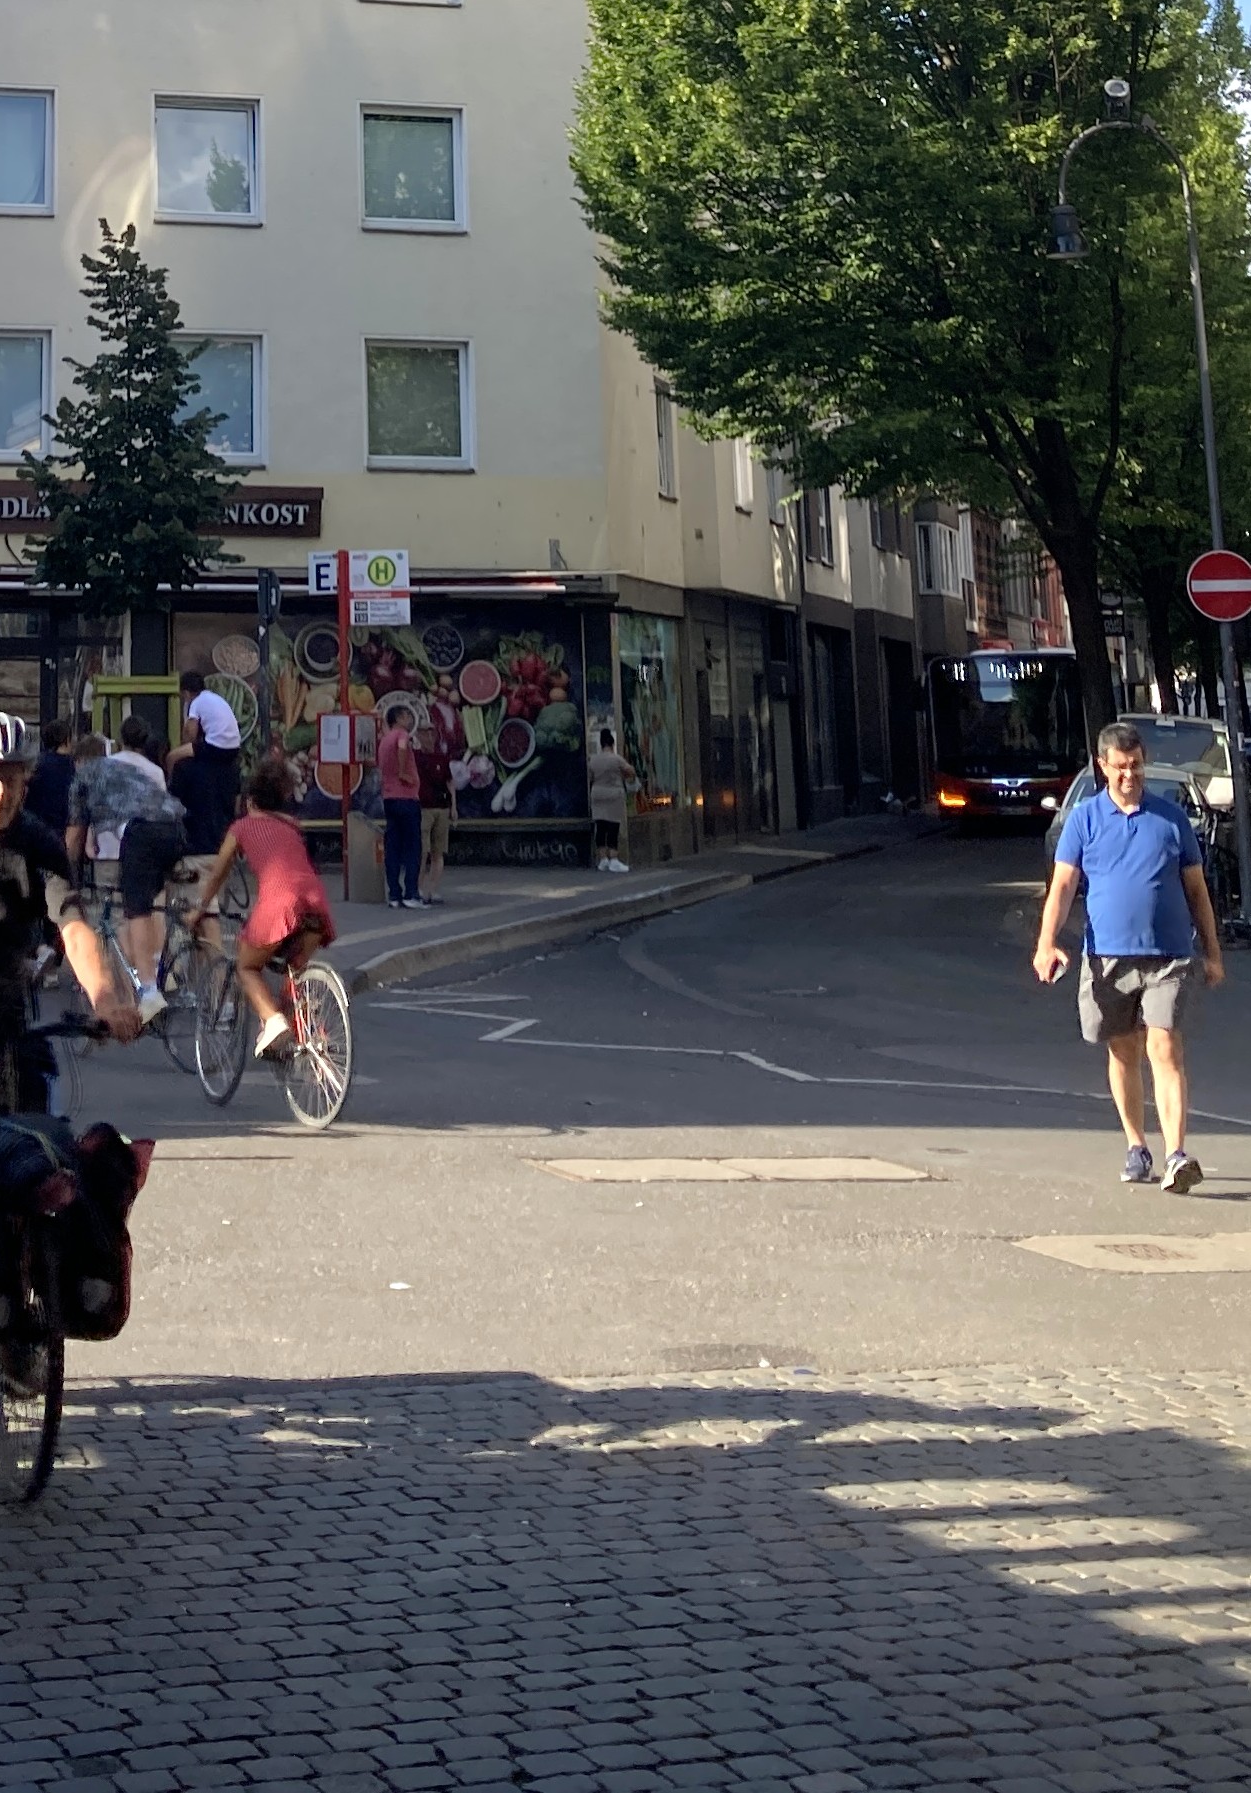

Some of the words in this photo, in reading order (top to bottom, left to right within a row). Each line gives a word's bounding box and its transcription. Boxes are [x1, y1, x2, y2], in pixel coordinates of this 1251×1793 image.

[223, 502, 310, 526] NKOST
[315, 563, 331, 591] E
[375, 561, 388, 580] H
